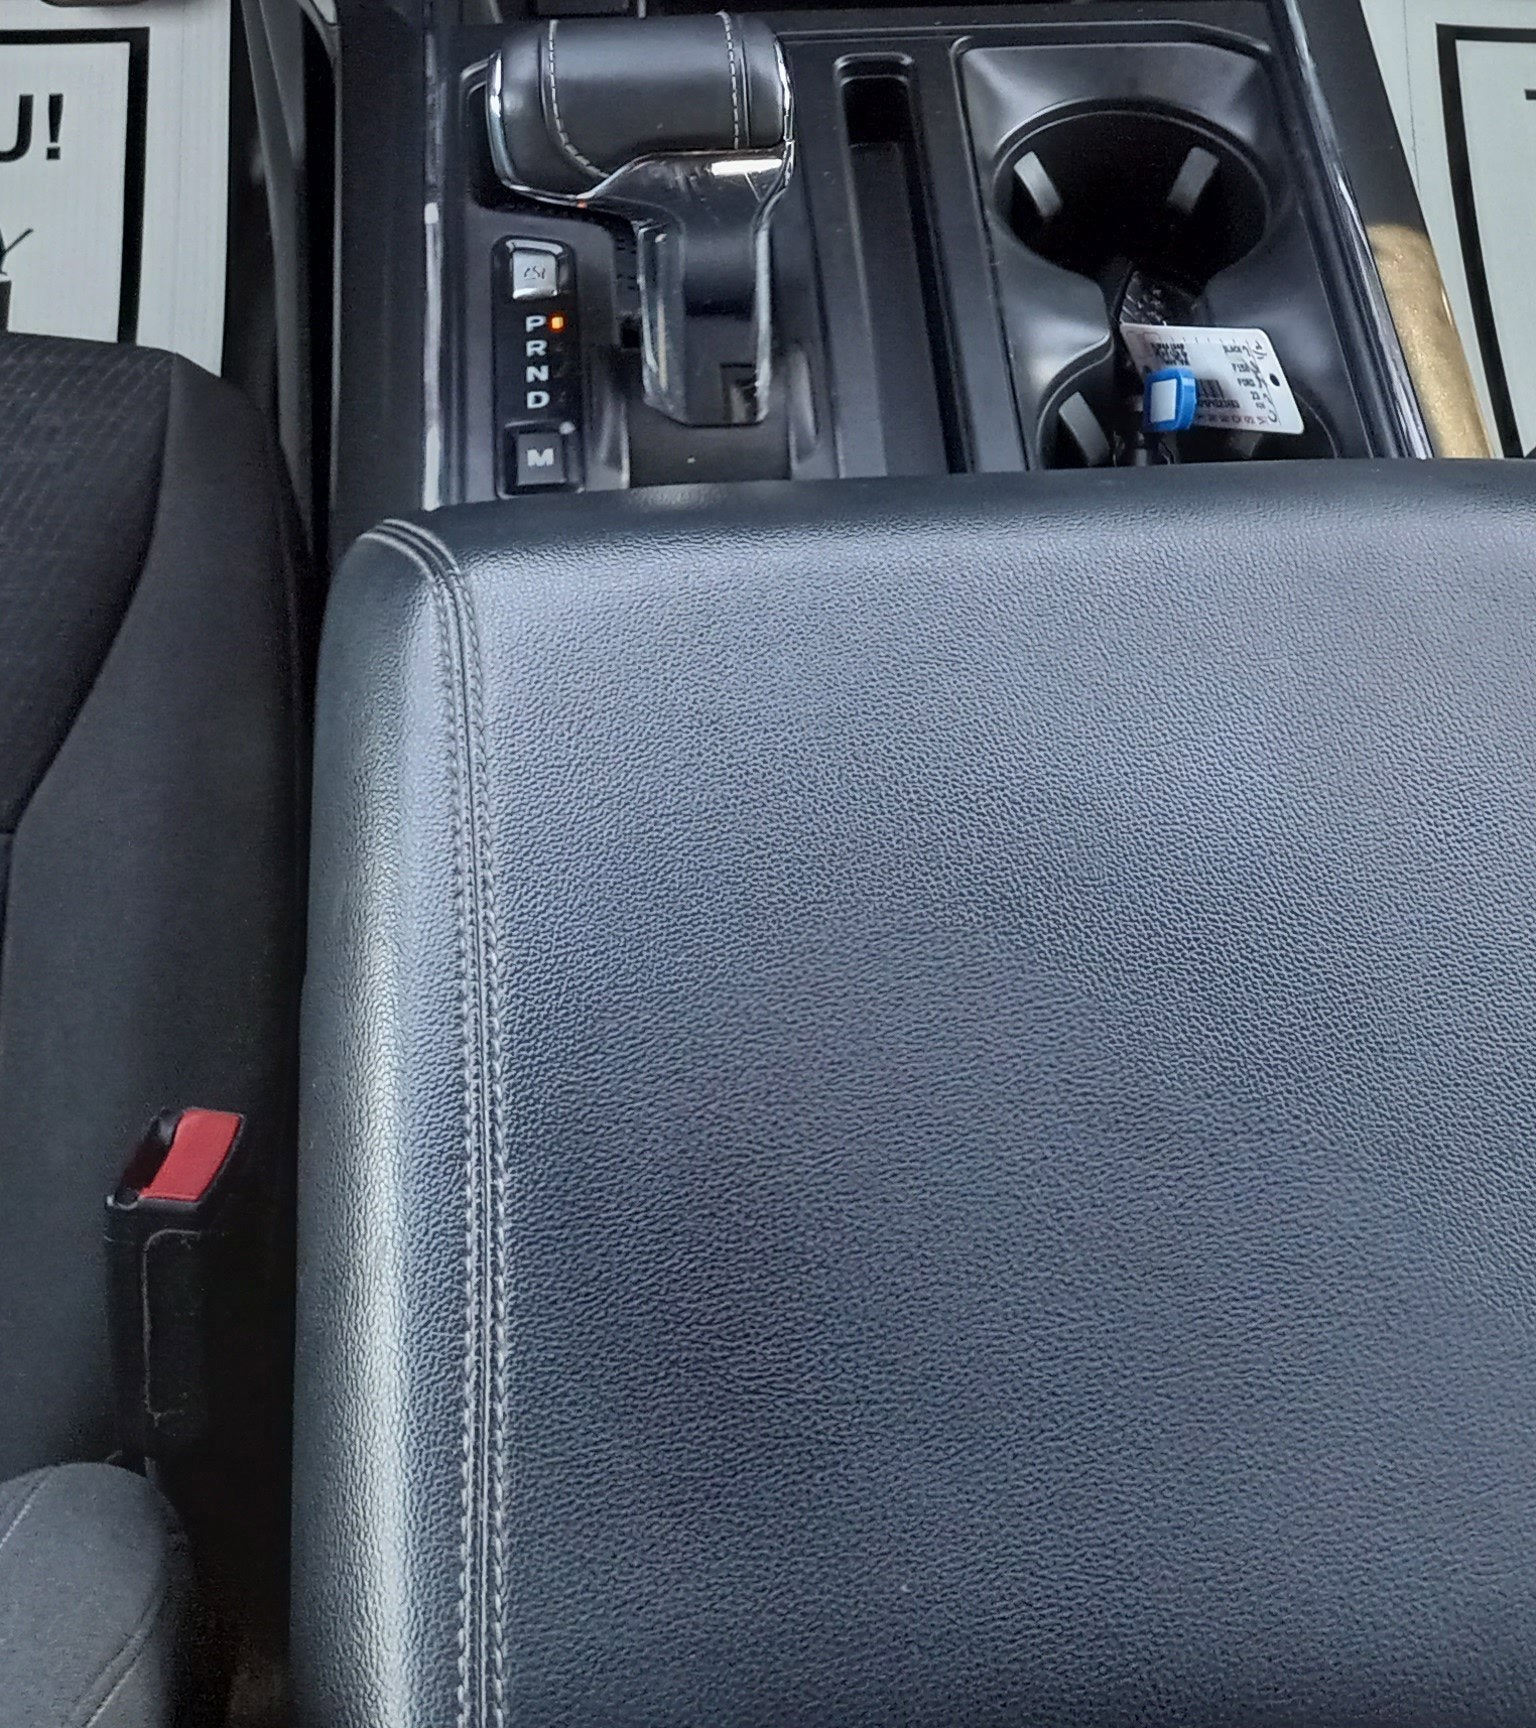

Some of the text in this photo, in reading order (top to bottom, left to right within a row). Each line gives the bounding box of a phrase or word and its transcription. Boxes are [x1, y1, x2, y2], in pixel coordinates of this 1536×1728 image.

[525, 315, 547, 332] P
[525, 340, 548, 357] R
[526, 365, 549, 382] N
[527, 391, 550, 409] D
[527, 448, 554, 467] M
